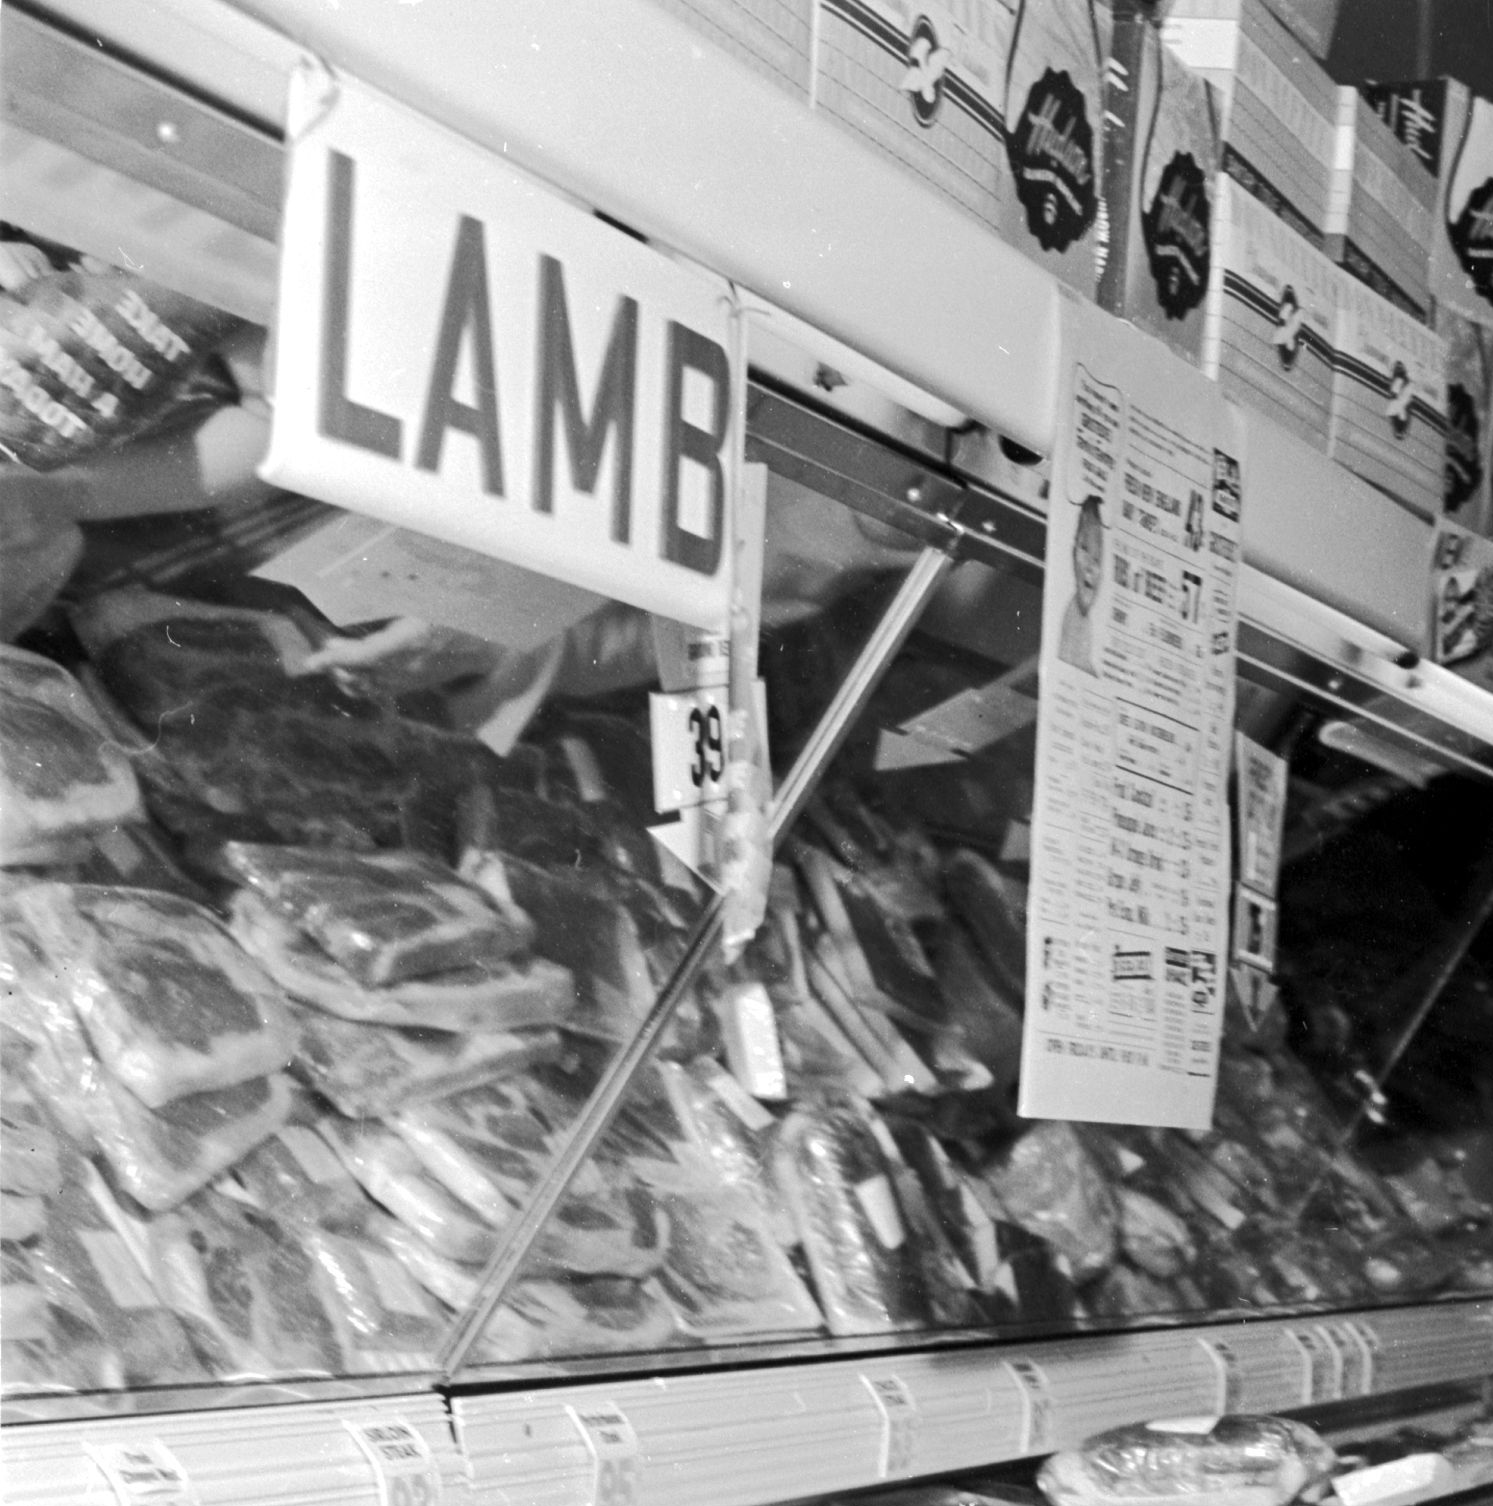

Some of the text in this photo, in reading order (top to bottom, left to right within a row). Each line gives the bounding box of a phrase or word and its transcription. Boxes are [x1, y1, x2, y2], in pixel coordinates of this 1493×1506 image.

[318, 147, 731, 578] LAMB
[688, 704, 725, 787] 39
[380, 1443, 422, 1460] STEAK
